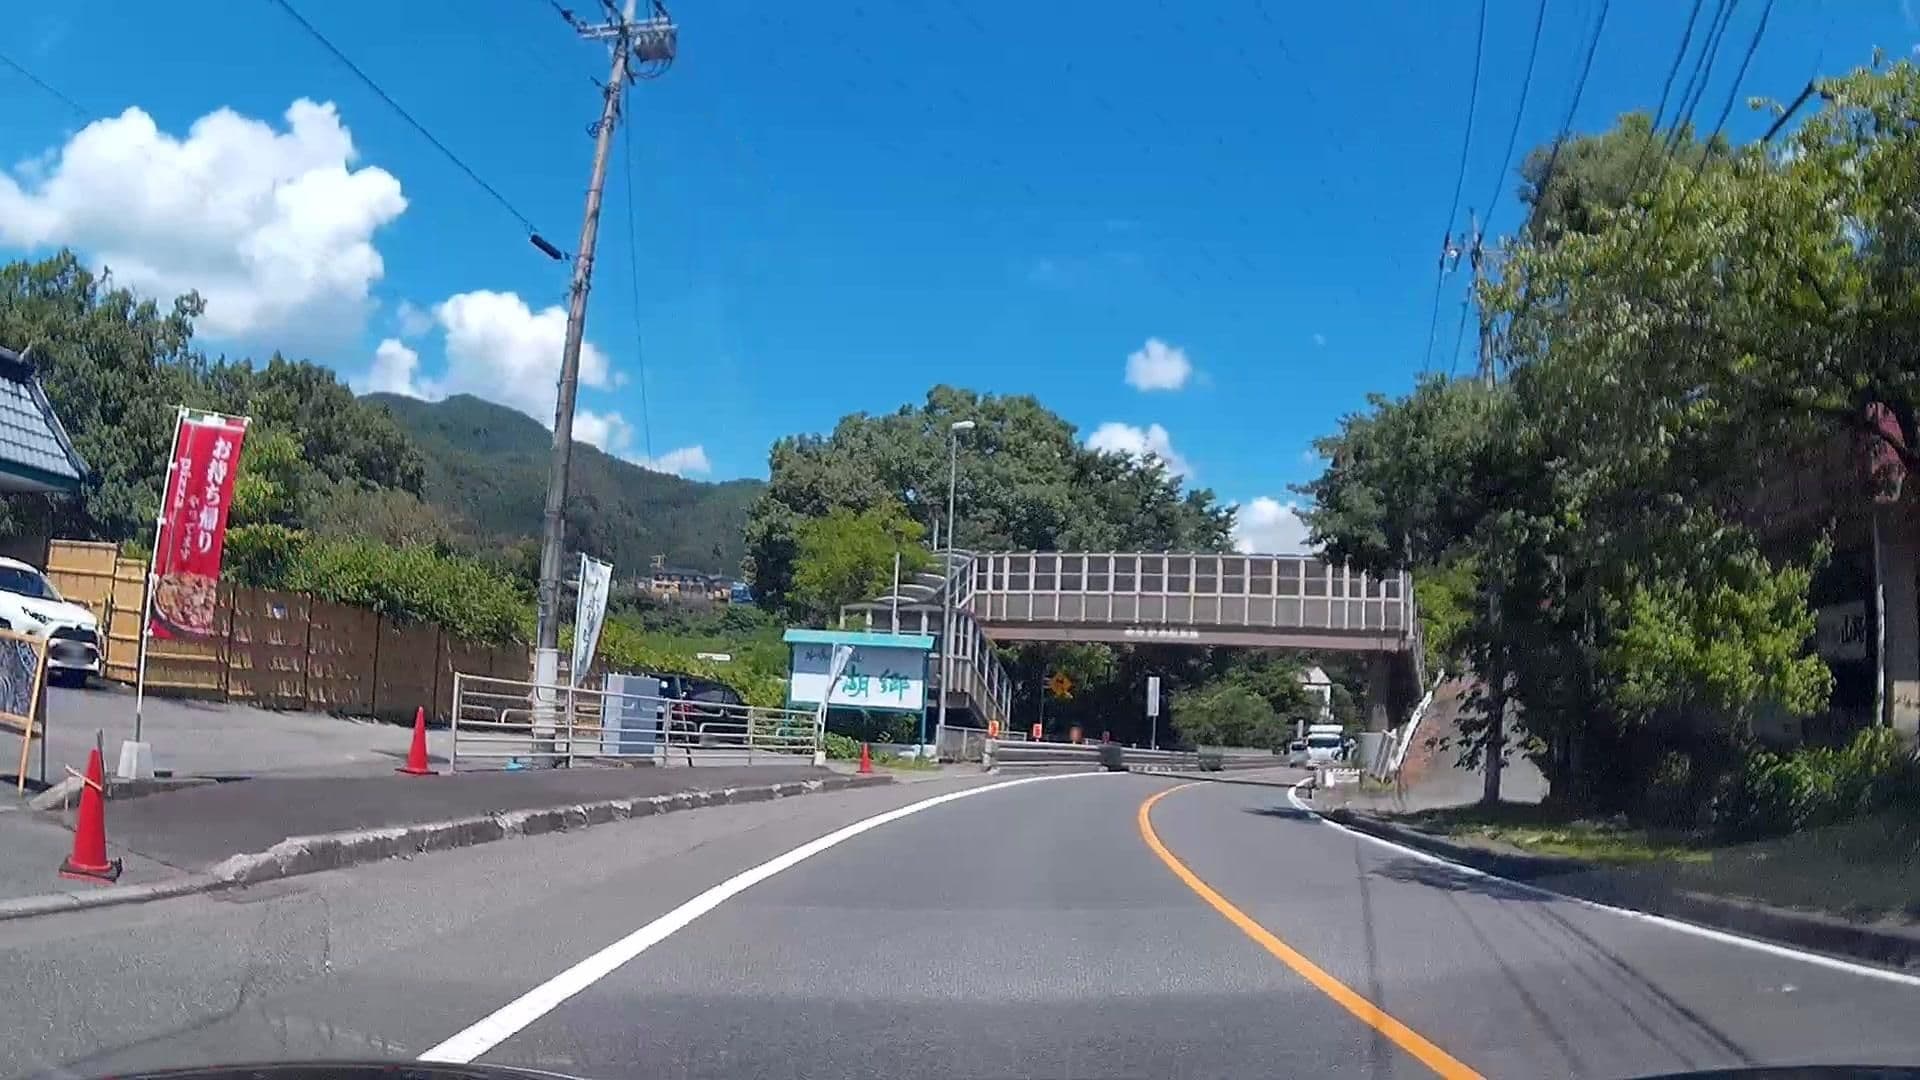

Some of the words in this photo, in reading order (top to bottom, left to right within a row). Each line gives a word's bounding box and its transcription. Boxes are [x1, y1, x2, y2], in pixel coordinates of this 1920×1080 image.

[198, 437, 232, 552] お持ち帰り
